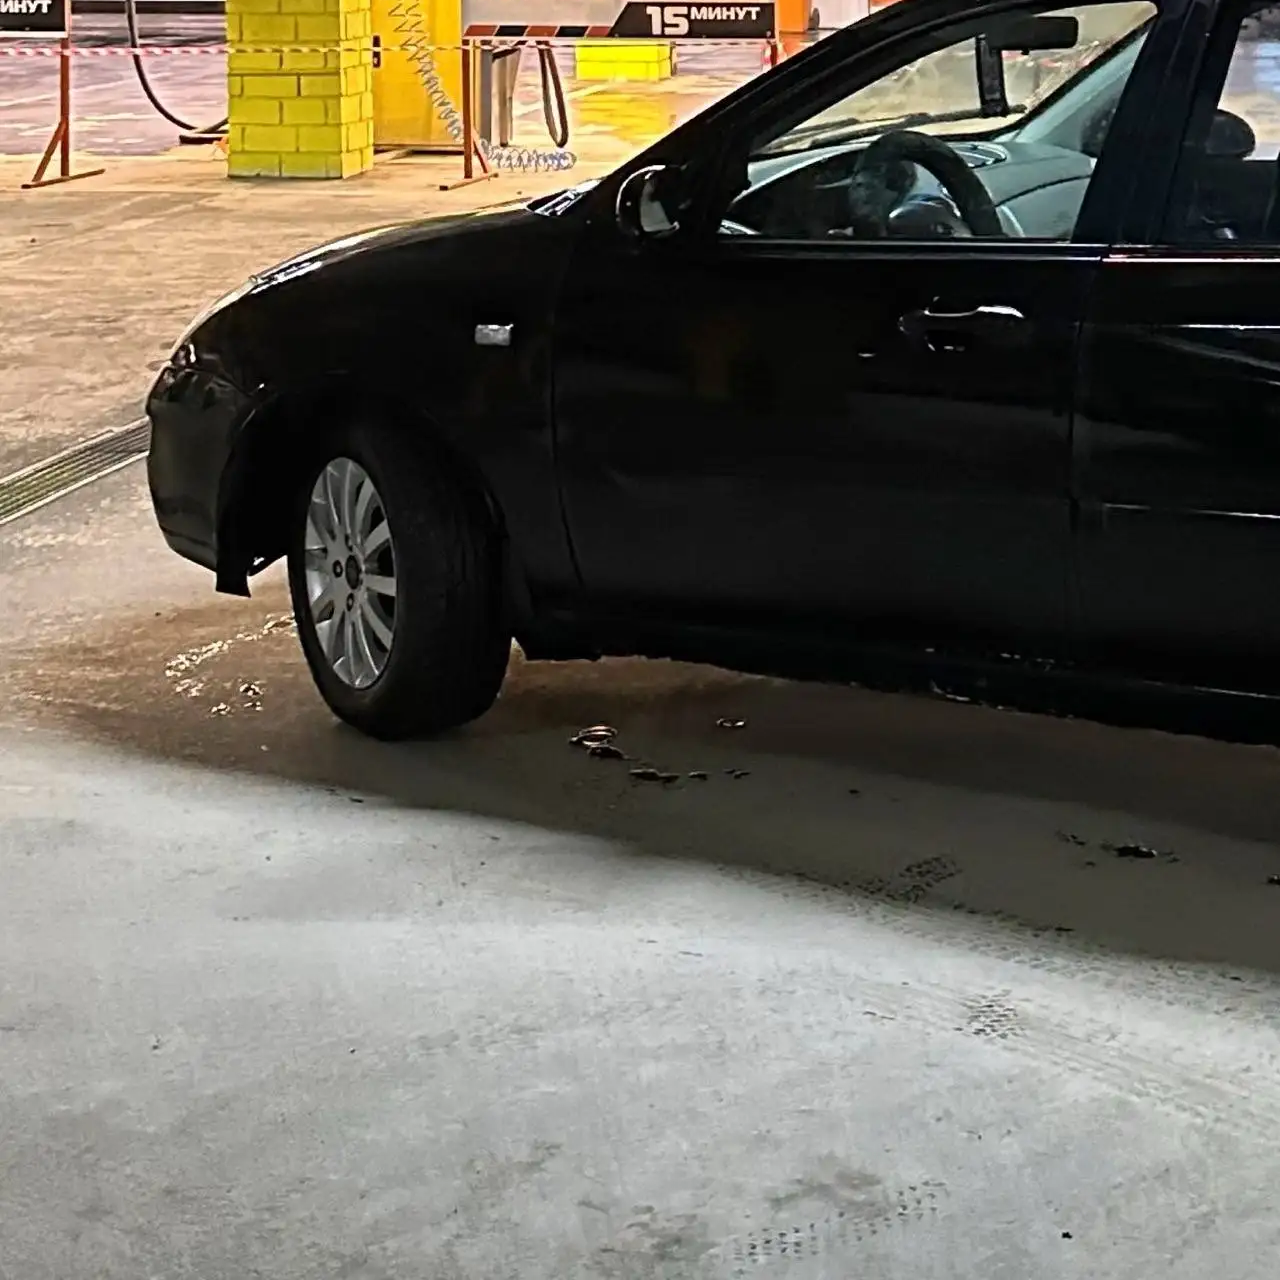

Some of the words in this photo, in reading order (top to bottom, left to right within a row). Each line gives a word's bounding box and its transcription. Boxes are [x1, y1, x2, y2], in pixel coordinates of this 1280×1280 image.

[0, 0, 52, 14] ИНУТ
[646, 6, 688, 36] 15
[690, 6, 761, 20] МИНУТ
